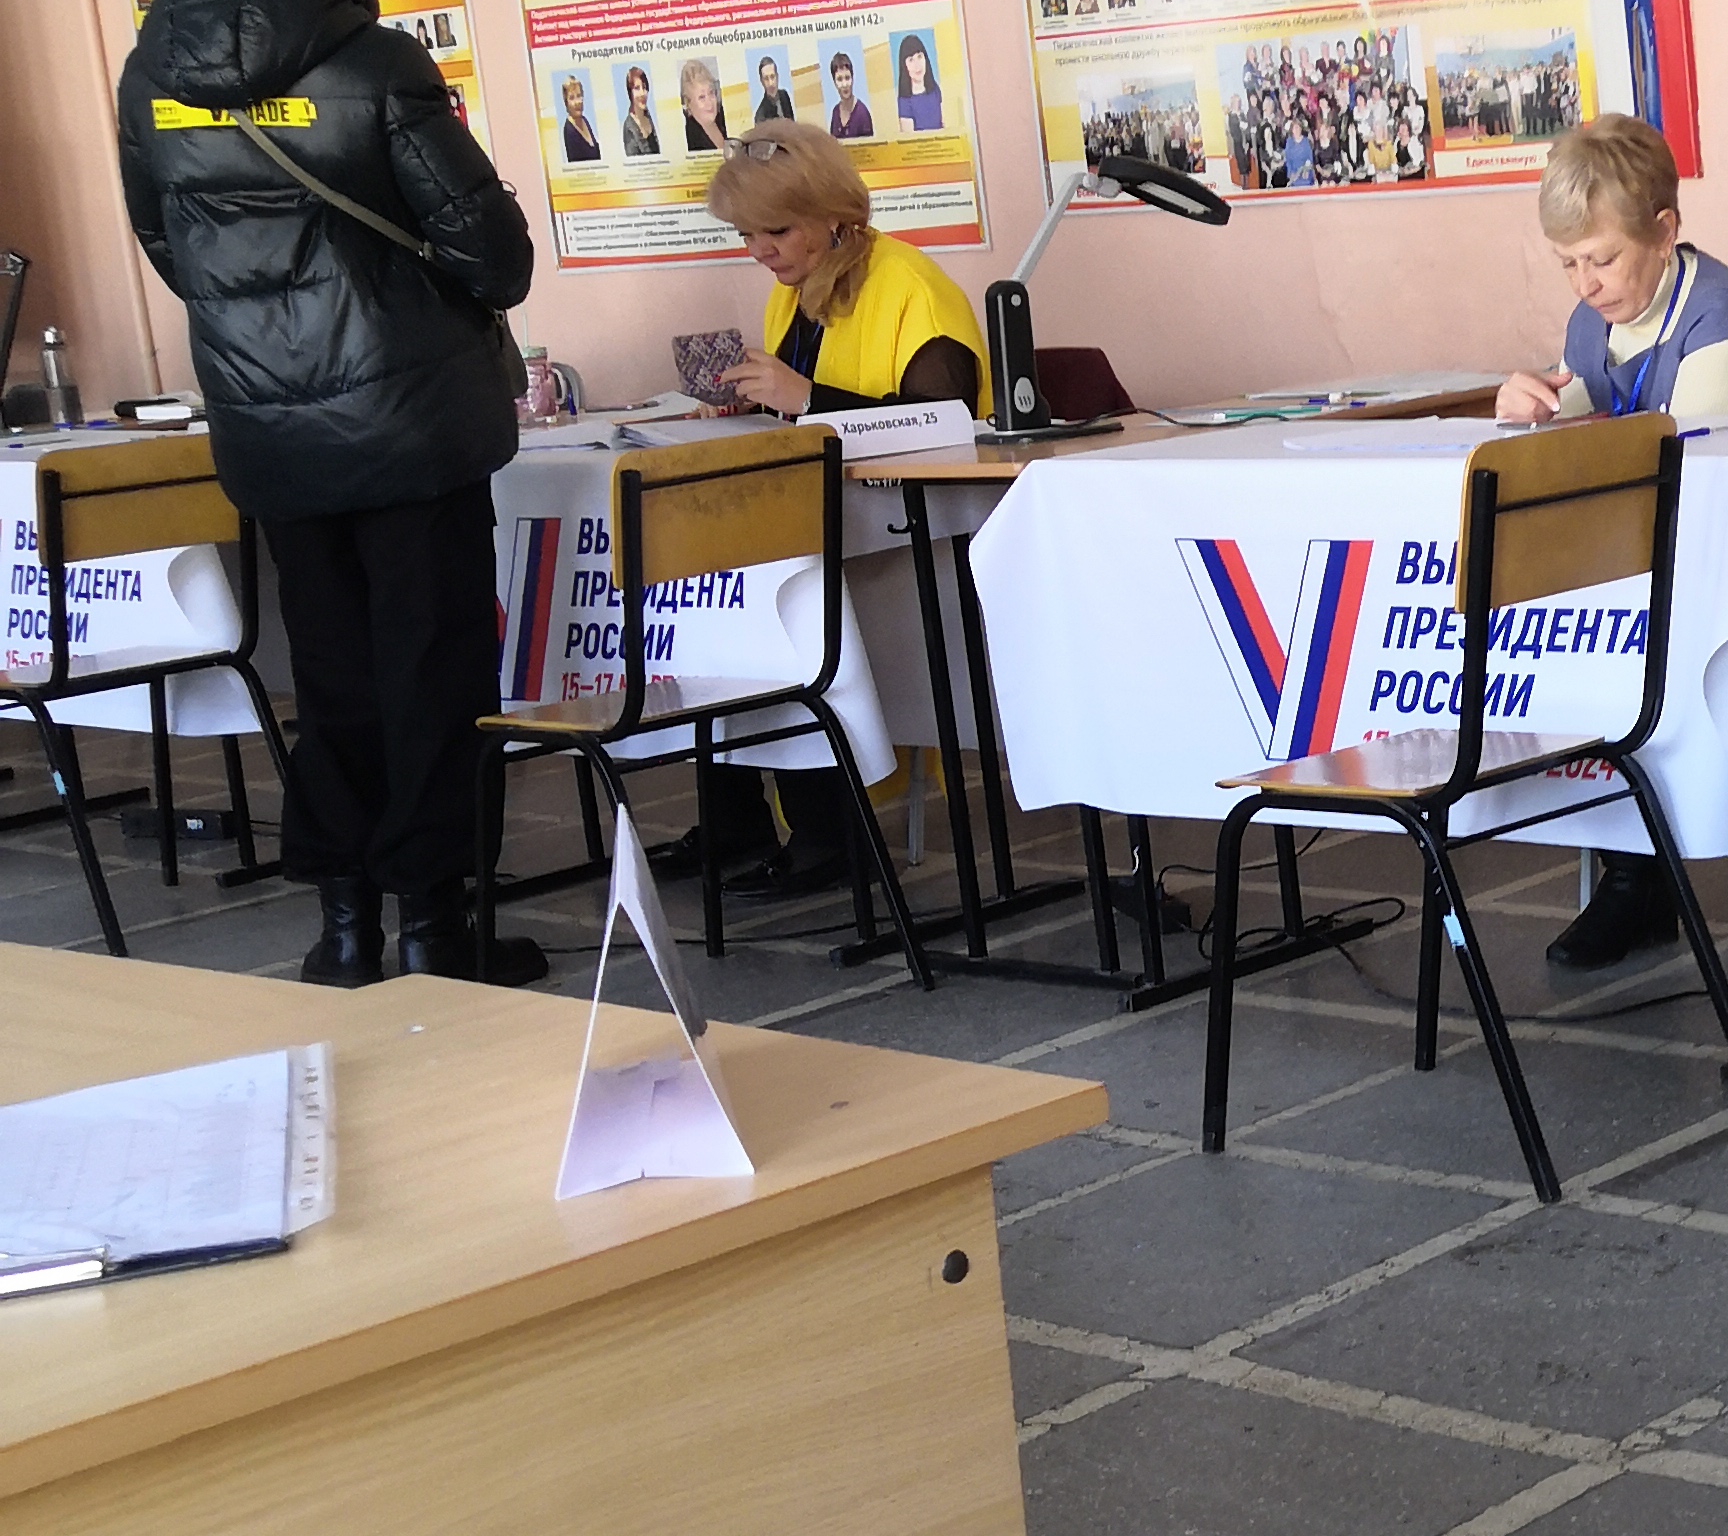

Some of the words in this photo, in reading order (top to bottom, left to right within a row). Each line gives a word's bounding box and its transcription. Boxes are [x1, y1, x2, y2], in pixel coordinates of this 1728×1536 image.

[571, 43, 635, 62] Руководители
[636, 38, 654, 53] БОУ
[702, 21, 814, 48] общеобразовательная
[815, 15, 848, 33] школа
[922, 411, 938, 424] 25
[11, 564, 142, 604] ПРЕИДЕНТА
[570, 570, 745, 614] ПРЕИДЕНТА
[7, 607, 90, 643] РОСИИ
[1382, 606, 1651, 660] ПРЕИДЕНТА
